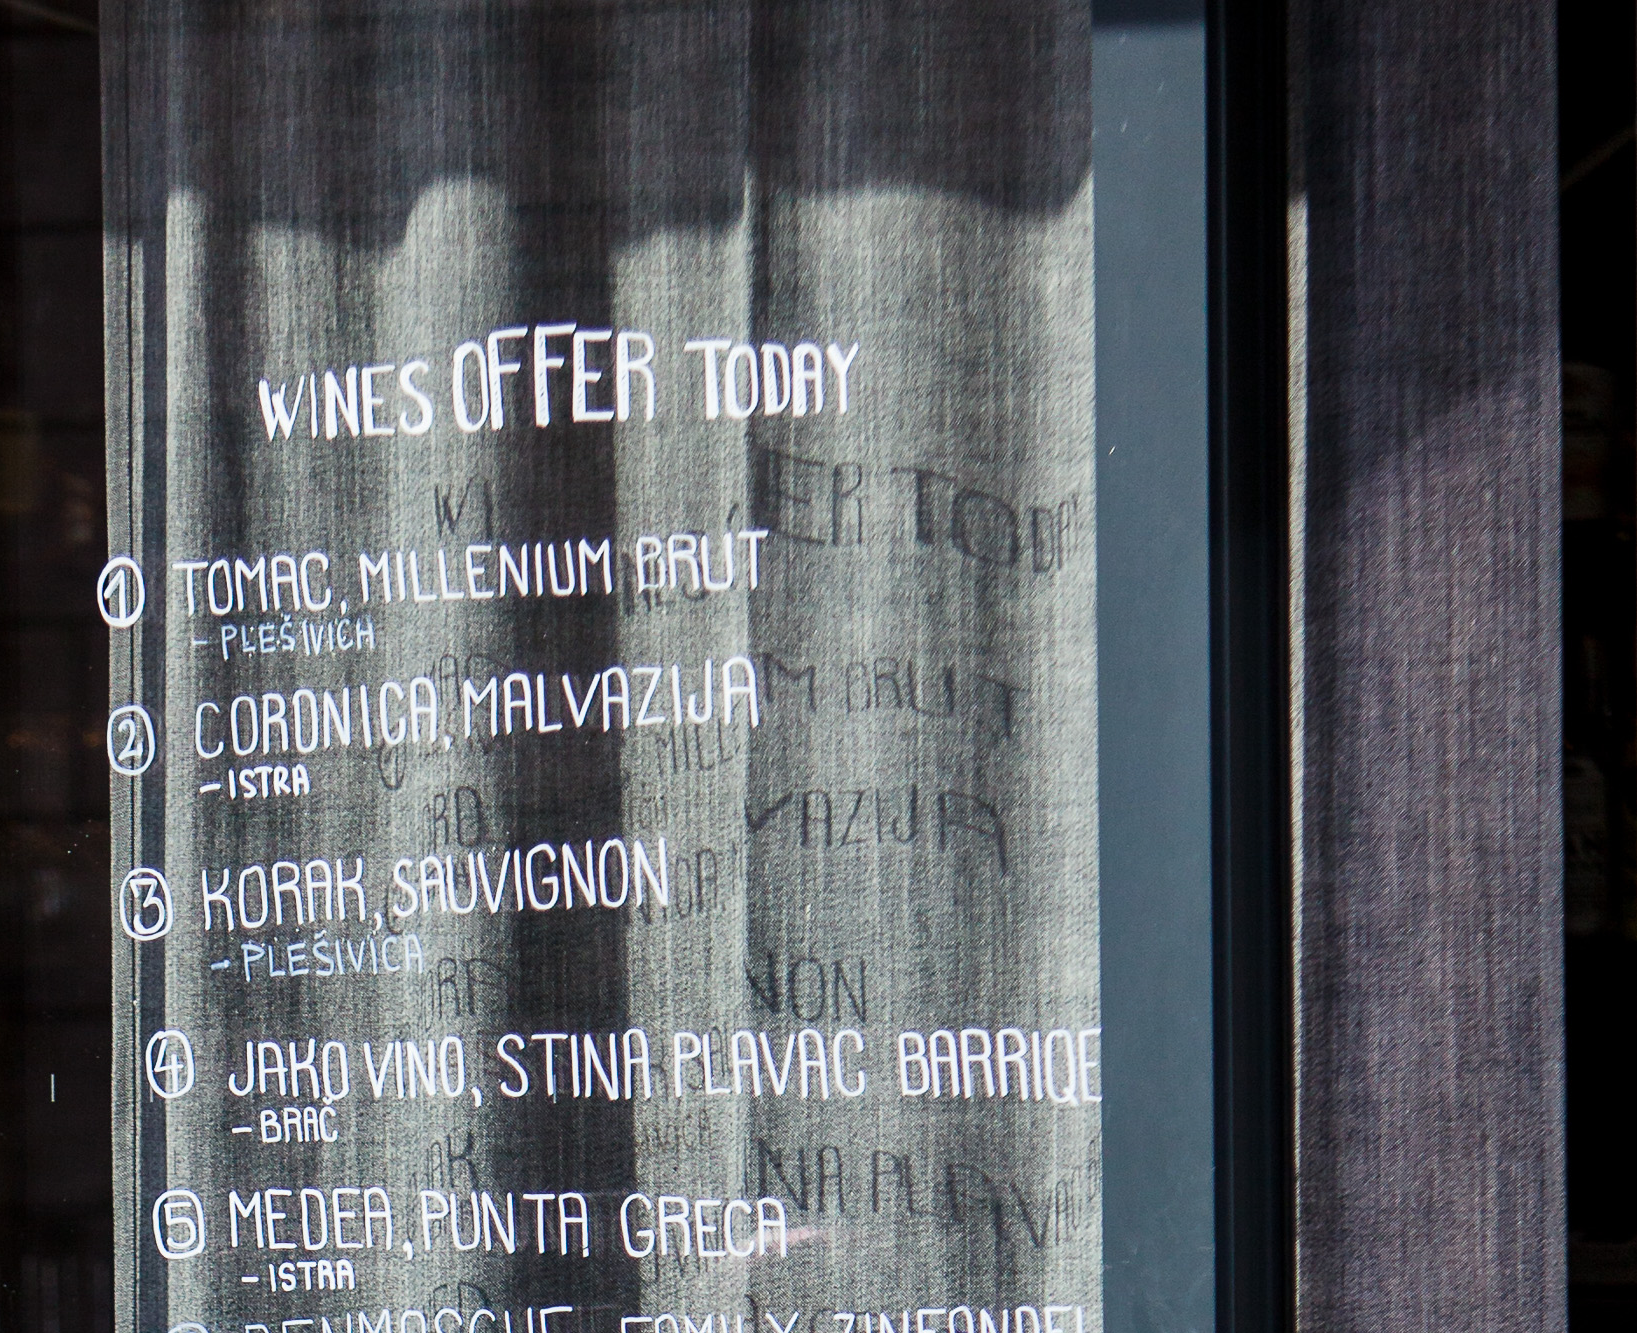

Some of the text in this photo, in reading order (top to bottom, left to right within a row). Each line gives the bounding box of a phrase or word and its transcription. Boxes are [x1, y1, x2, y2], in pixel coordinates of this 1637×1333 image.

[258, 322, 860, 441] WINES OFFER TODAY
[171, 551, 348, 618] TOMAC,
[358, 539, 612, 604] MILLENIUM
[634, 528, 770, 595] BRUT
[461, 655, 760, 740] MALVAZIJA
[200, 856, 384, 935] KORAK,
[391, 836, 670, 919] SAUVIGNON
[227, 1038, 350, 1100] JAKO
[496, 1028, 653, 1101] STINA
[672, 1027, 867, 1101] PLAVAC
[896, 1024, 1104, 1109] BARRIQE
[418, 1189, 590, 1258] PUNTA
[619, 1192, 792, 1259] GRECA
